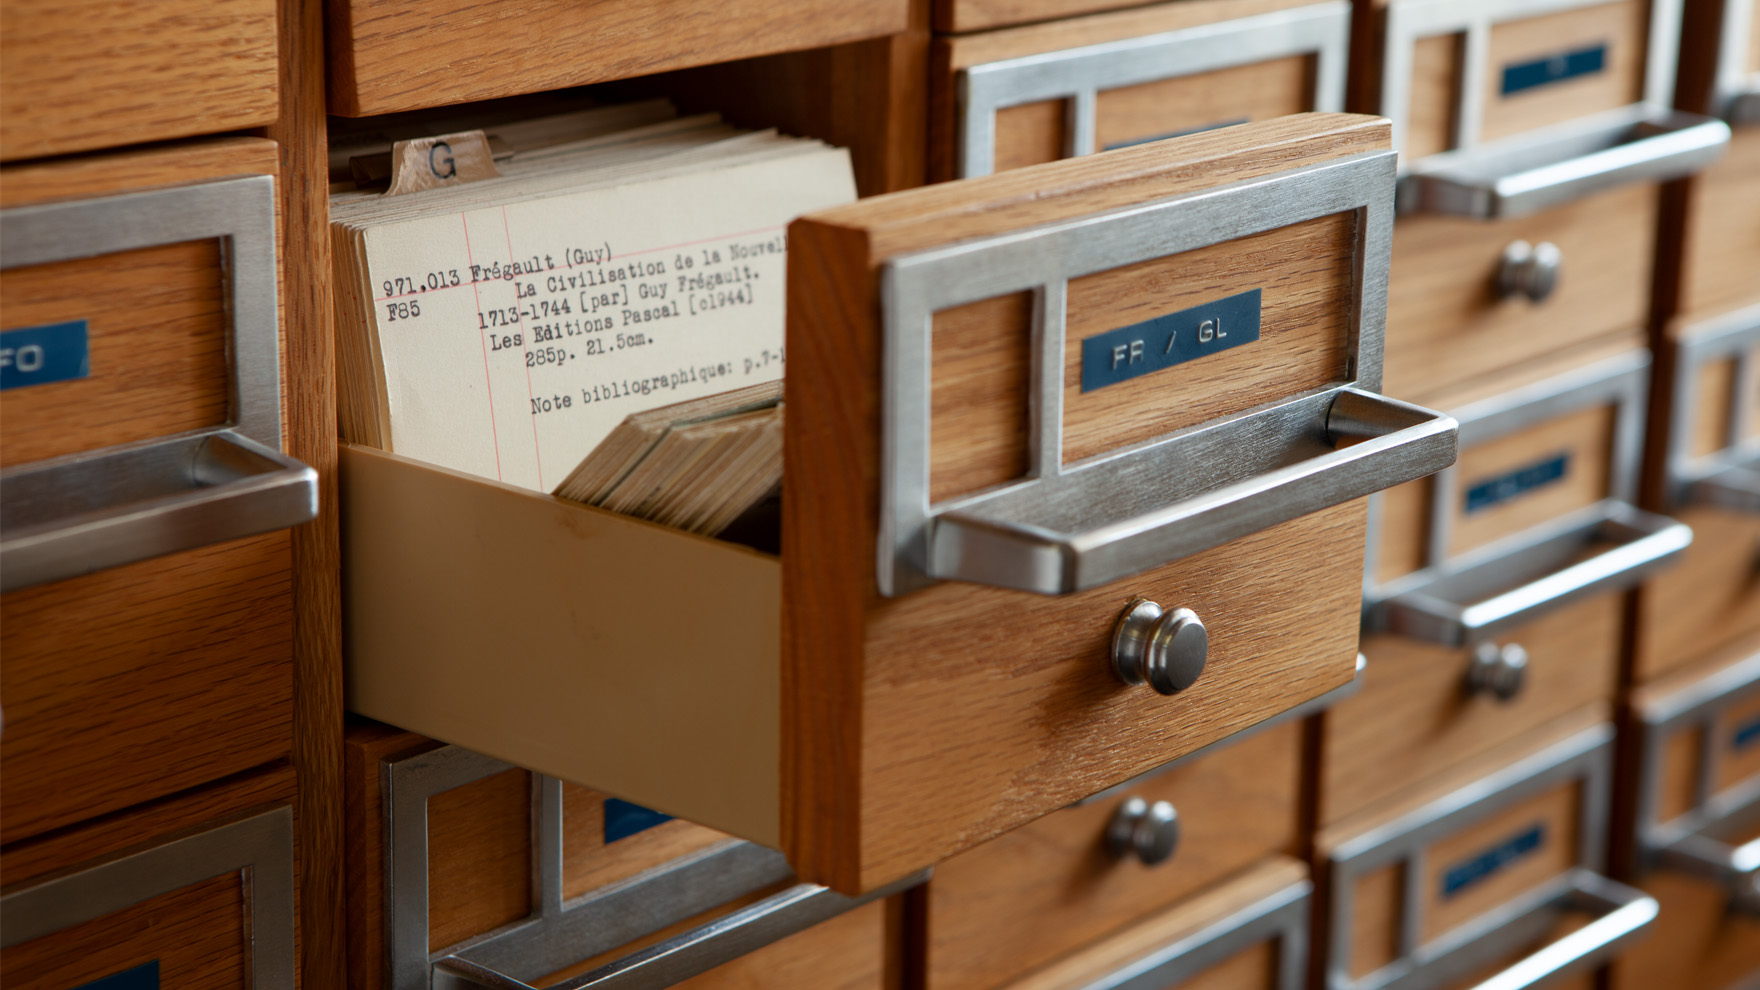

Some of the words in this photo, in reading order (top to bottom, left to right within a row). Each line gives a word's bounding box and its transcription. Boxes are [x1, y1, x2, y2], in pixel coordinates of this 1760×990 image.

[429, 140, 457, 180] G
[469, 254, 555, 283] Frégault
[565, 241, 613, 270] (Guy)
[515, 281, 538, 300] La
[547, 261, 665, 293] Civilisation
[674, 253, 694, 271] de
[702, 248, 722, 267] la
[386, 300, 421, 322] F85
[478, 298, 572, 329] 1713-1744
[580, 283, 630, 314] [par]
[638, 280, 668, 300] Guy
[677, 264, 761, 294] Frégault.
[490, 333, 523, 351] Les
[532, 316, 613, 343] Editions
[621, 300, 681, 327] Pascal
[1165, 329, 1178, 356] /
[1199, 317, 1228, 344] GL
[525, 346, 577, 368] 285p.
[586, 333, 655, 357] 21.5cm.
[530, 394, 573, 415] Note
[582, 362, 732, 404] bibliographique:
